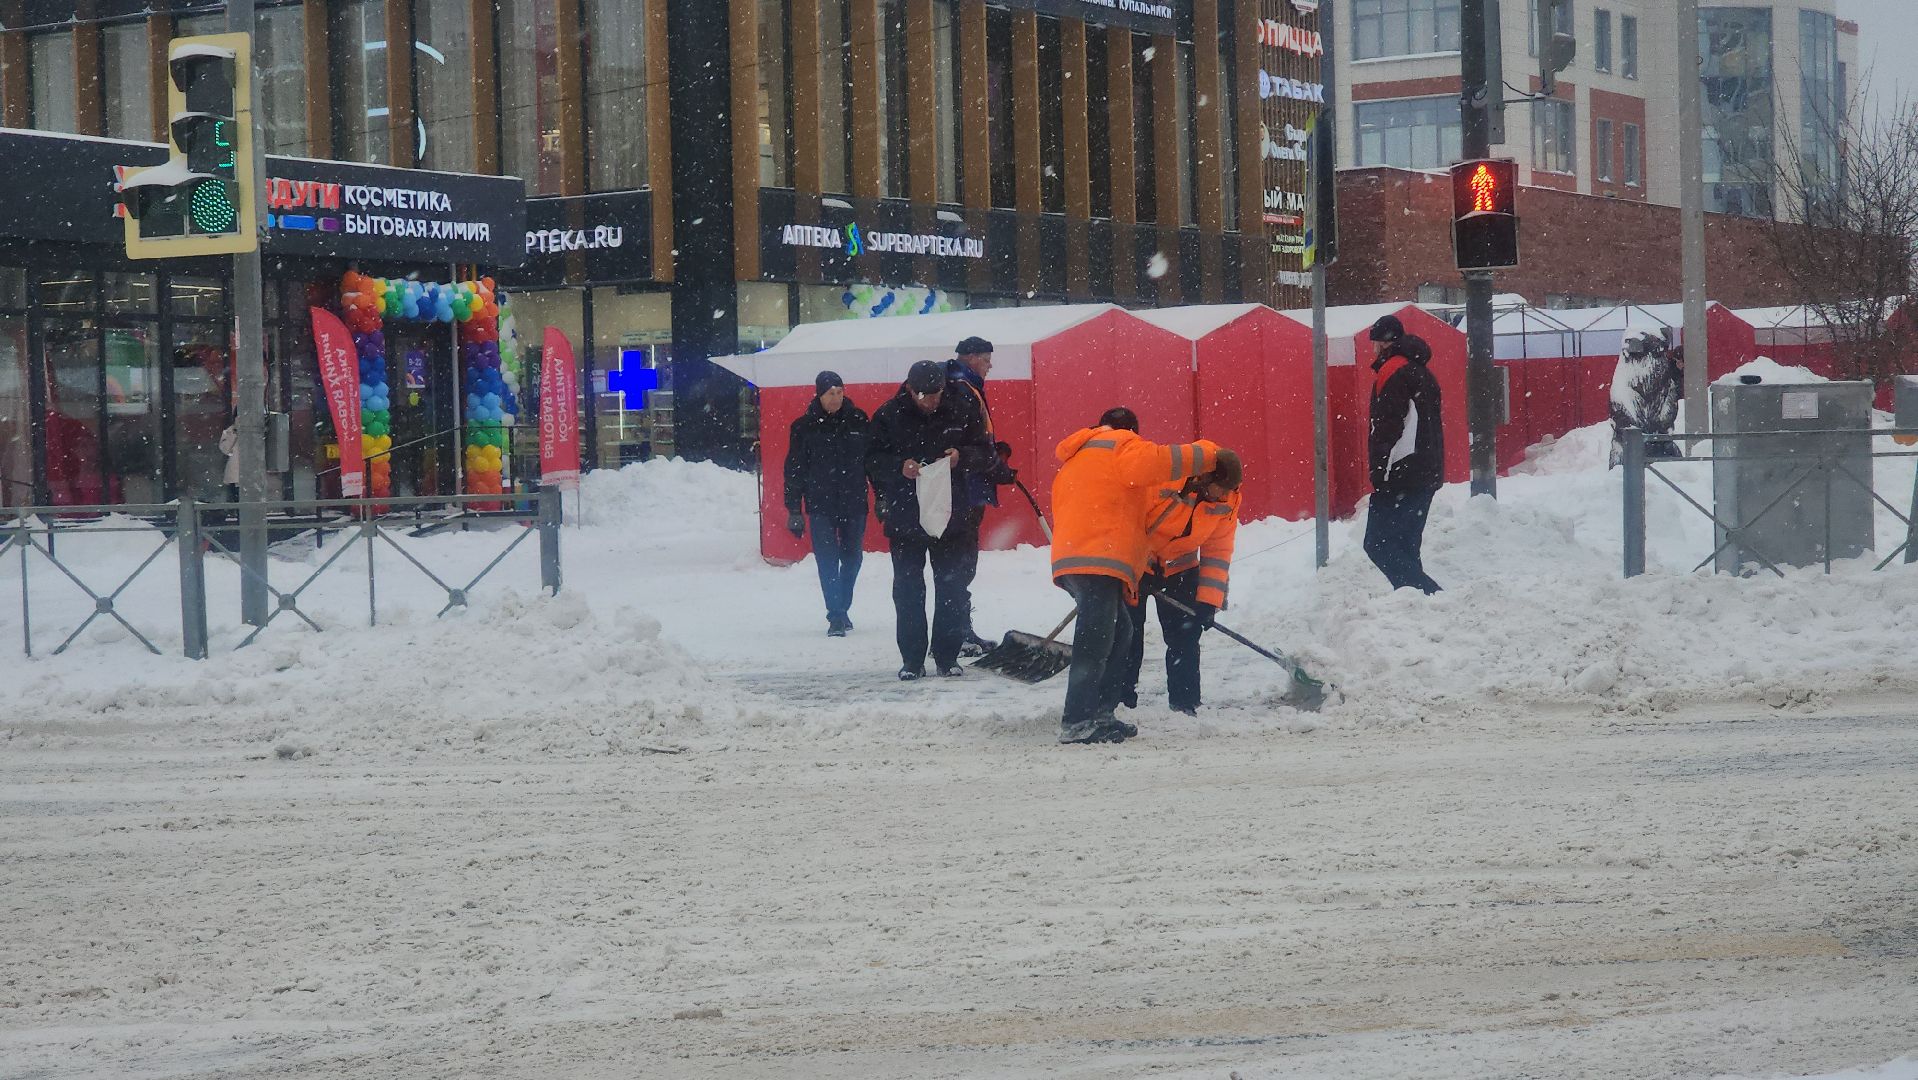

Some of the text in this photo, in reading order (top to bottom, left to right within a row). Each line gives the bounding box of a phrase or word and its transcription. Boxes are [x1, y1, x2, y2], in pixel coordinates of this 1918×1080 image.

[1118, 0, 1172, 19] КУПАЛЬНИКИ
[1264, 18, 1323, 59] ПИЦЦА
[1269, 75, 1325, 103] ТАБАК
[345, 185, 452, 212] КОСМЕТИКА
[345, 213, 490, 242] БЫТОВАЯ ХИМИЯ
[782, 224, 841, 248] АПТЕКА
[866, 231, 983, 258] SUPERAPTEKA.RU
